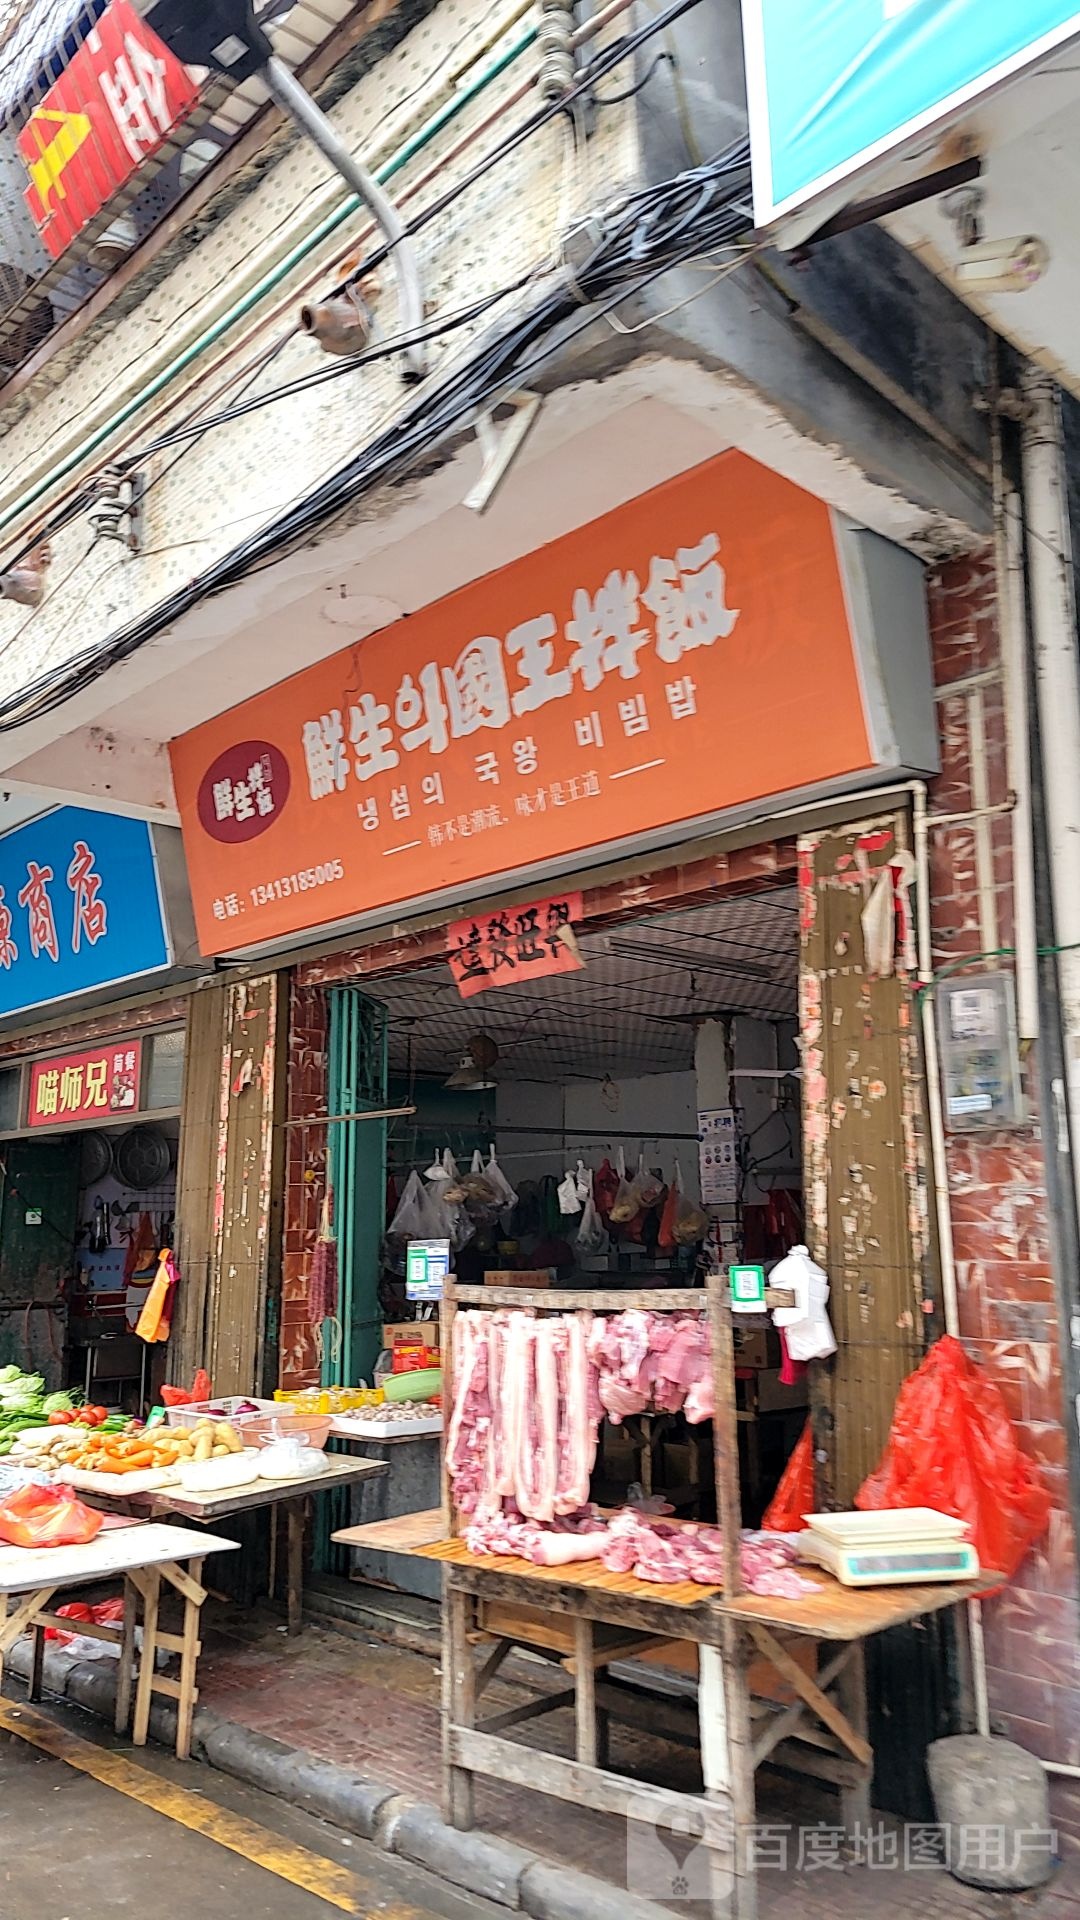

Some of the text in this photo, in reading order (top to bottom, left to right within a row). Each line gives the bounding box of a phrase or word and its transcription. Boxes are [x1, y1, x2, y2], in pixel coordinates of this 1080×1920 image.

[474, 736, 538, 784] 국왕
[574, 675, 697, 748] 비빔밥
[250, 858, 344, 907] 13413185005
[36, 1058, 109, 1116] 喵师兄
